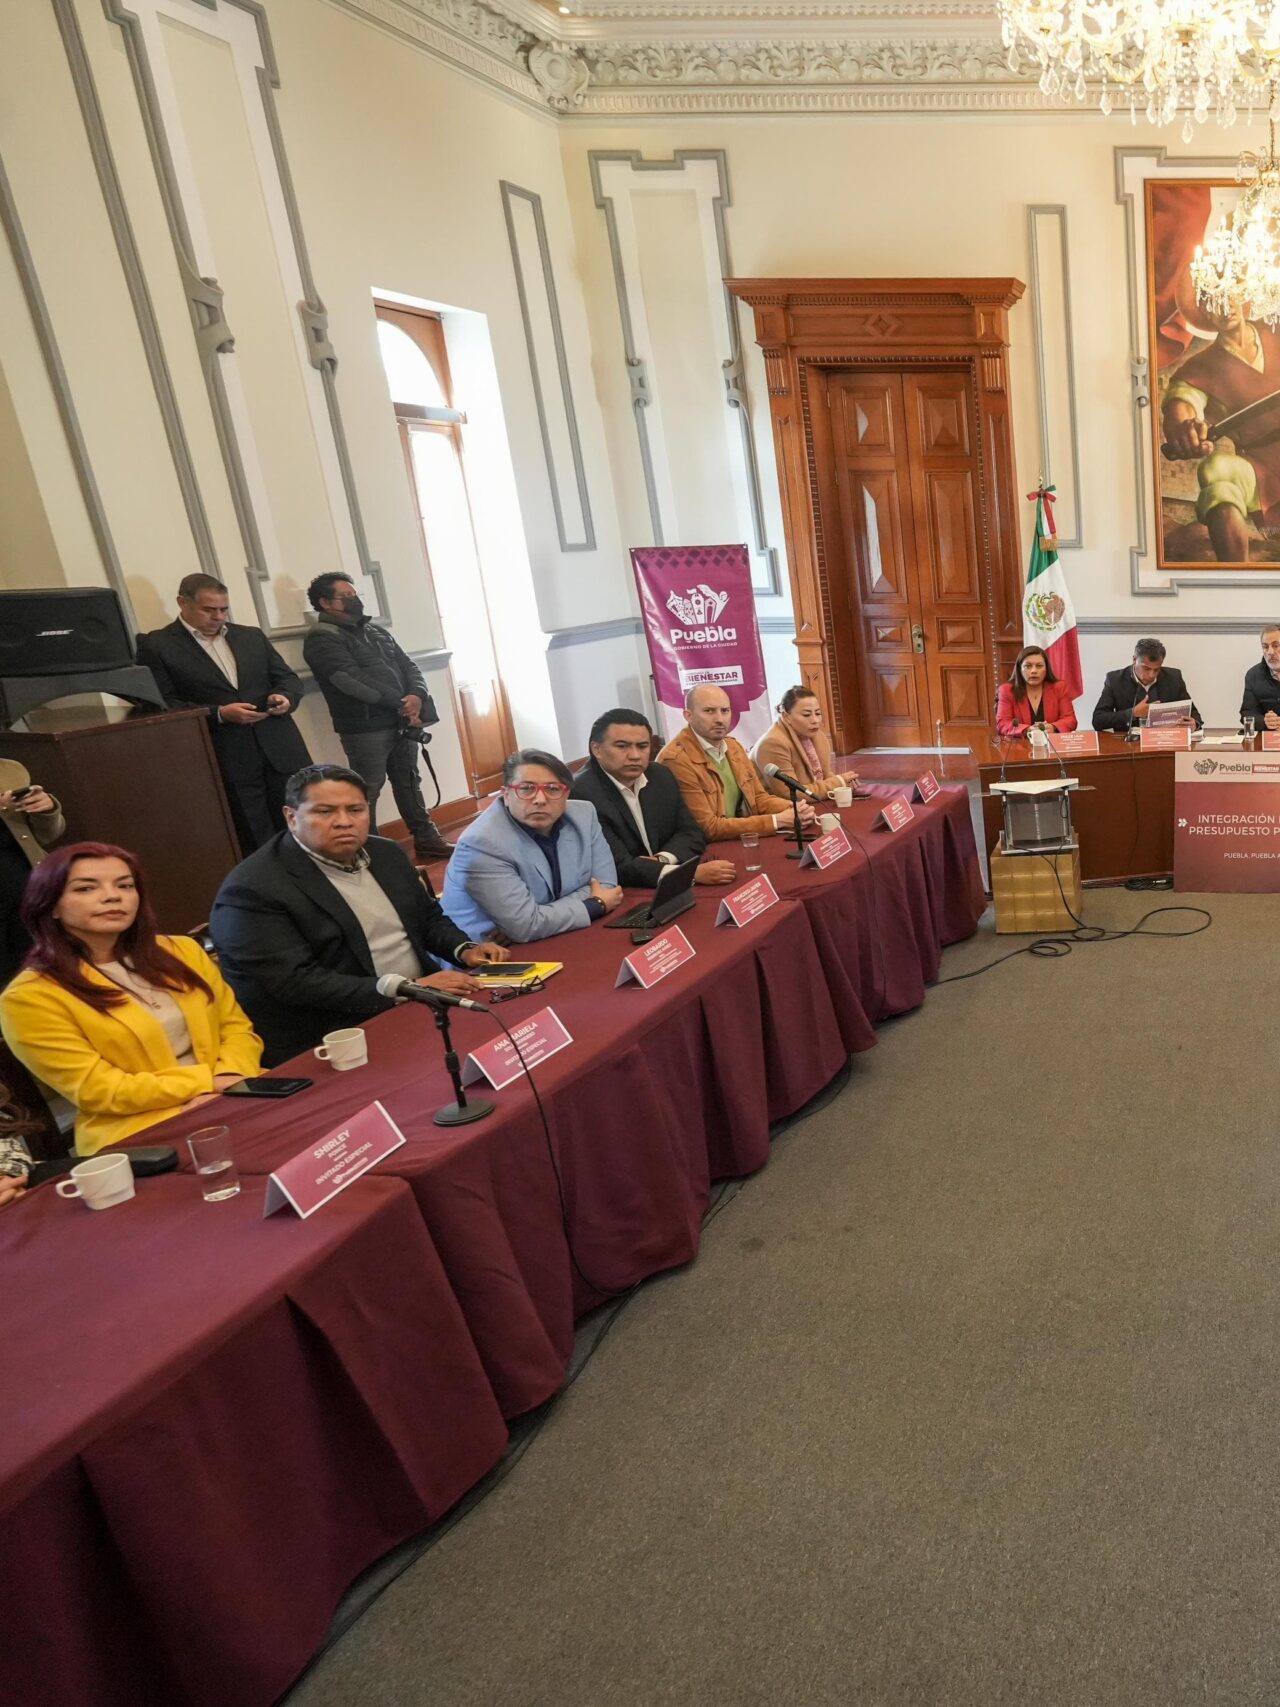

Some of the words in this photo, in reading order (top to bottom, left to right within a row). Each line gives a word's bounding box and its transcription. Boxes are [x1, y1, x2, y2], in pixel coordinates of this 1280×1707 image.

[670, 626, 737, 644] Puebla
[686, 671, 738, 683] BIENESTAR
[1219, 763, 1251, 772] Puebla
[1198, 813, 1275, 824] INTEGRACIÓN
[1189, 826, 1270, 836] PRESUPUESTO
[644, 938, 668, 957] LEOBARDO
[493, 1038, 510, 1052] ANA
[526, 1037, 548, 1055] ESPECIAL
[314, 1129, 351, 1159] SHIRLEY
[328, 1143, 348, 1158] PONCE
[315, 1160, 346, 1185] INVITADO
[344, 1142, 373, 1164] ESPECIAL
